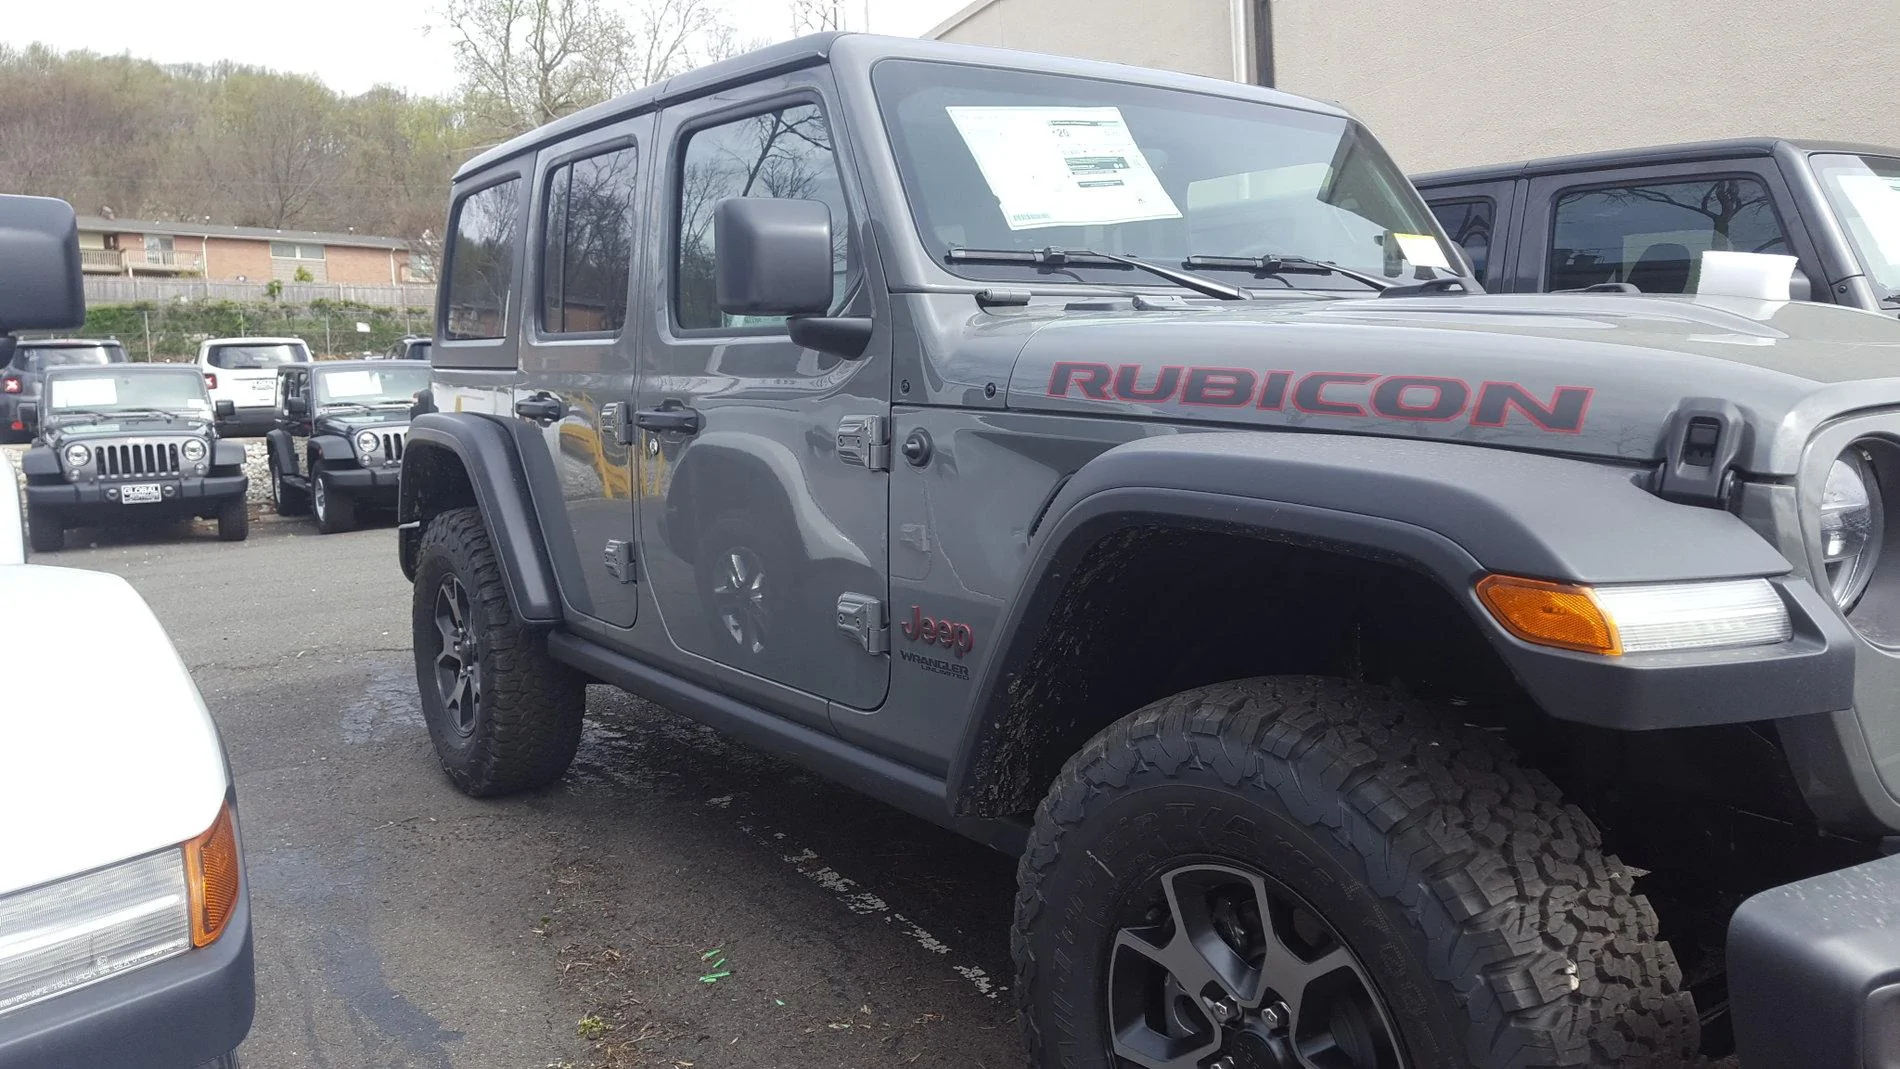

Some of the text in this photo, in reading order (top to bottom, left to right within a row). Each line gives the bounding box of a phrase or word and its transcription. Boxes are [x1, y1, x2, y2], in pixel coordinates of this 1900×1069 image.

[1046, 361, 1595, 435] RUBICON
[901, 605, 974, 659] Jeep
[900, 649, 969, 676] WRANGLER
